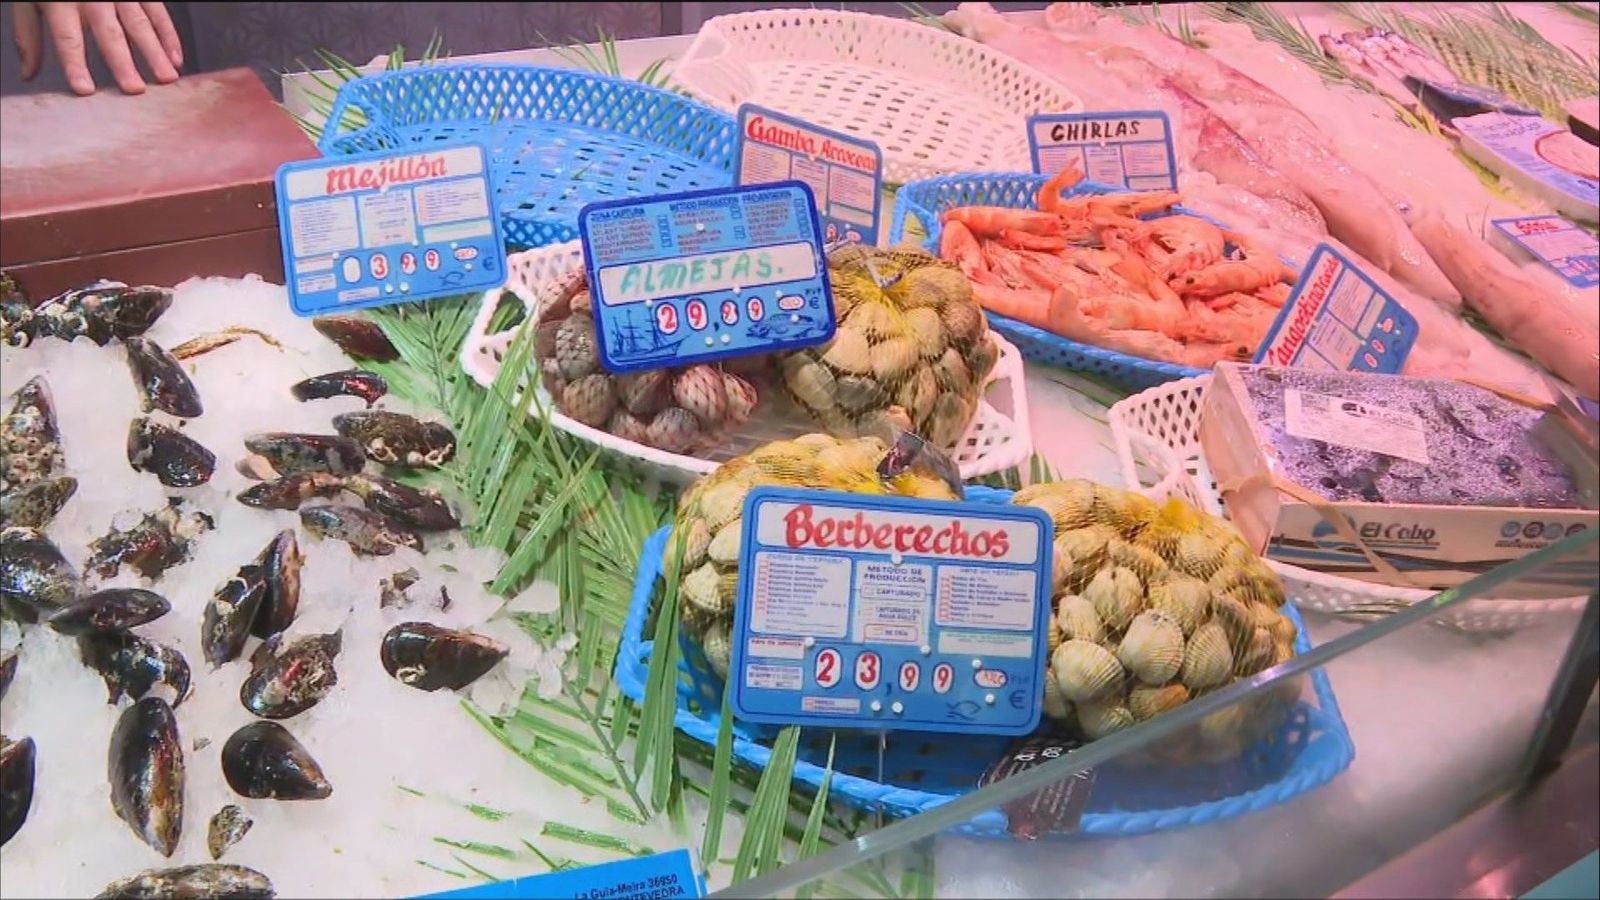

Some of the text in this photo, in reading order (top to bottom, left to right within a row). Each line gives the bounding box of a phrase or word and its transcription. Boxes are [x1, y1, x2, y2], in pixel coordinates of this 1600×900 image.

[1051, 120, 1141, 141] CHIRLAS
[326, 156, 447, 194] Mejillón
[784, 503, 1011, 558] Berberechos
